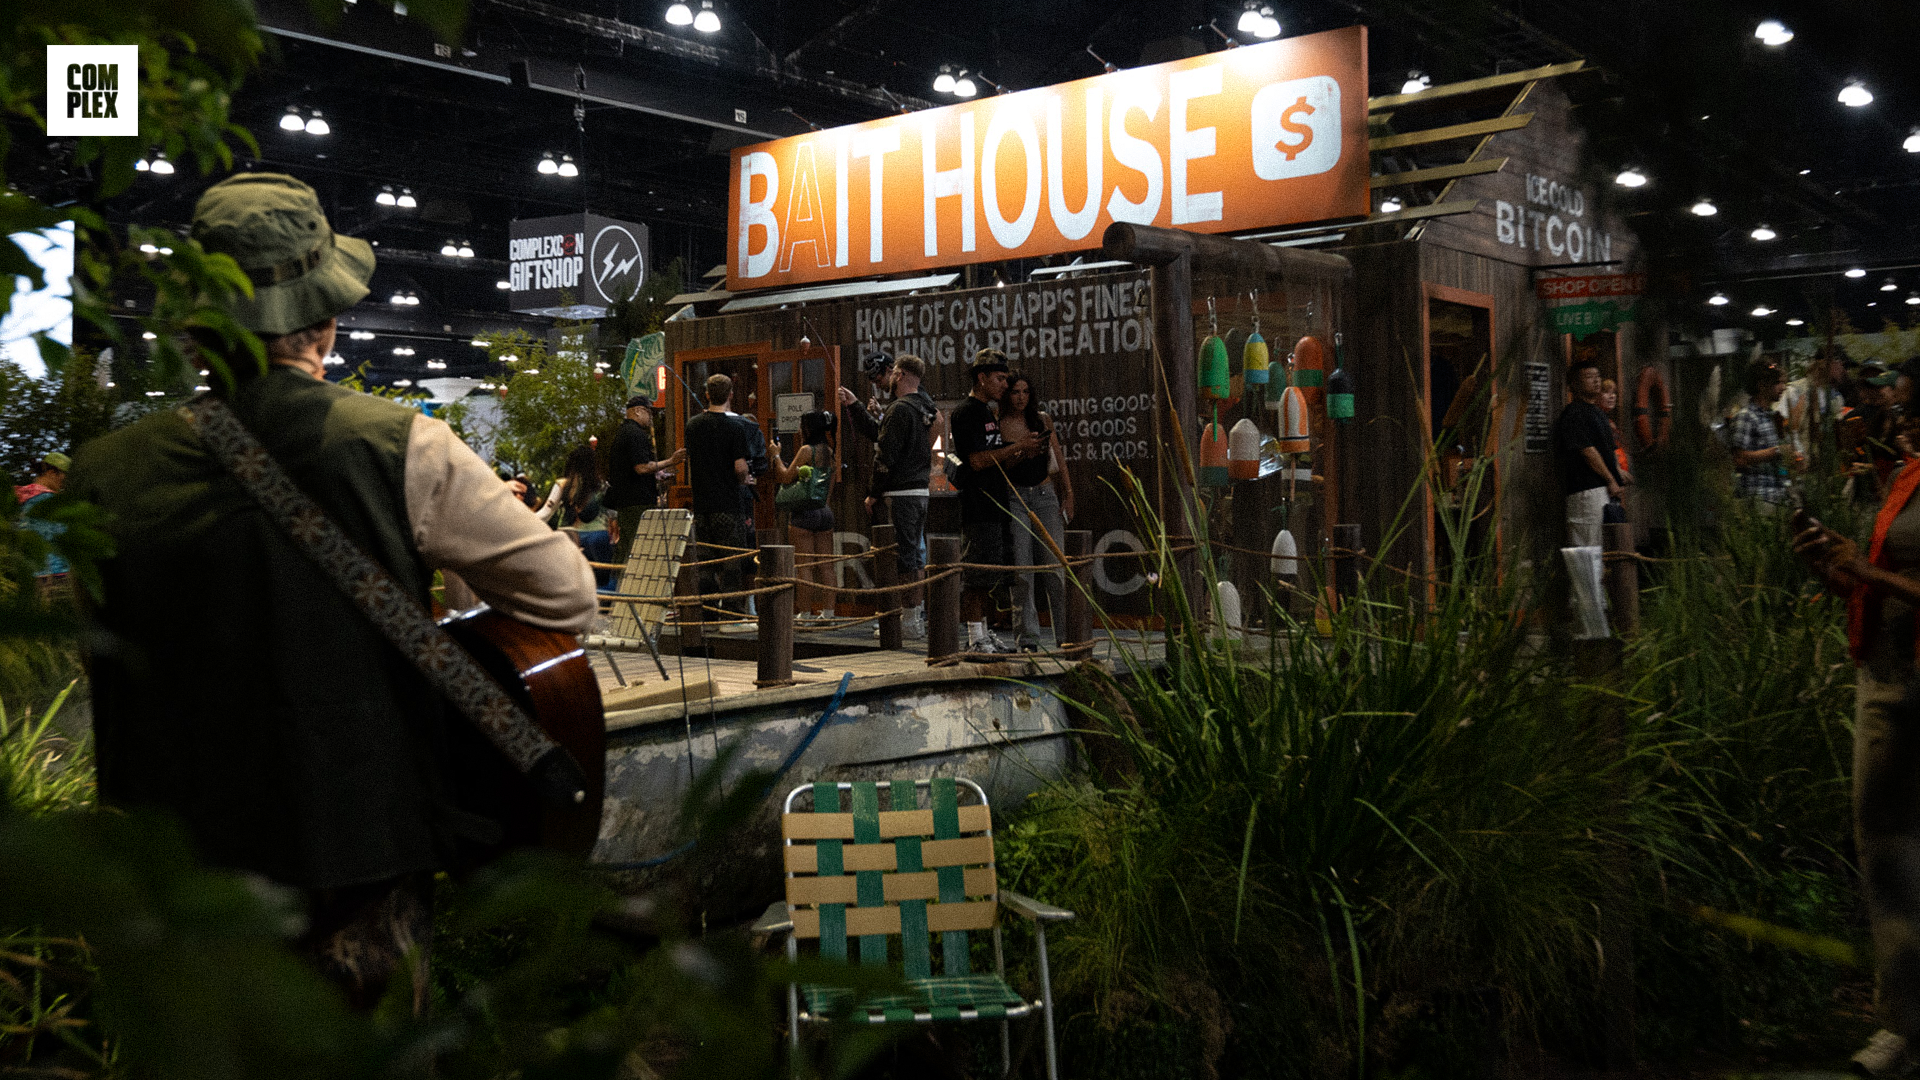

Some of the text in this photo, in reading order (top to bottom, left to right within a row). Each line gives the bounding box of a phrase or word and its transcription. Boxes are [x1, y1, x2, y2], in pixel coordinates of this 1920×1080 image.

[738, 124, 901, 278] BAIT
[921, 64, 1224, 256] HOUSE
[1526, 173, 1584, 217] ICE COLD
[1496, 200, 1611, 271] BITCOIN
[510, 256, 584, 292] GIFTSHOP
[1543, 280, 1587, 295] SHOP
[1588, 277, 1633, 293] OPEN
[855, 279, 1151, 340] HOME OF CASH APP'S FINES
[1556, 312, 1583, 326] LIVE
[963, 332, 980, 364] &
[988, 317, 1152, 362] RECREATION
[1077, 416, 1137, 437] GOODS
[1086, 442, 1098, 460] &
